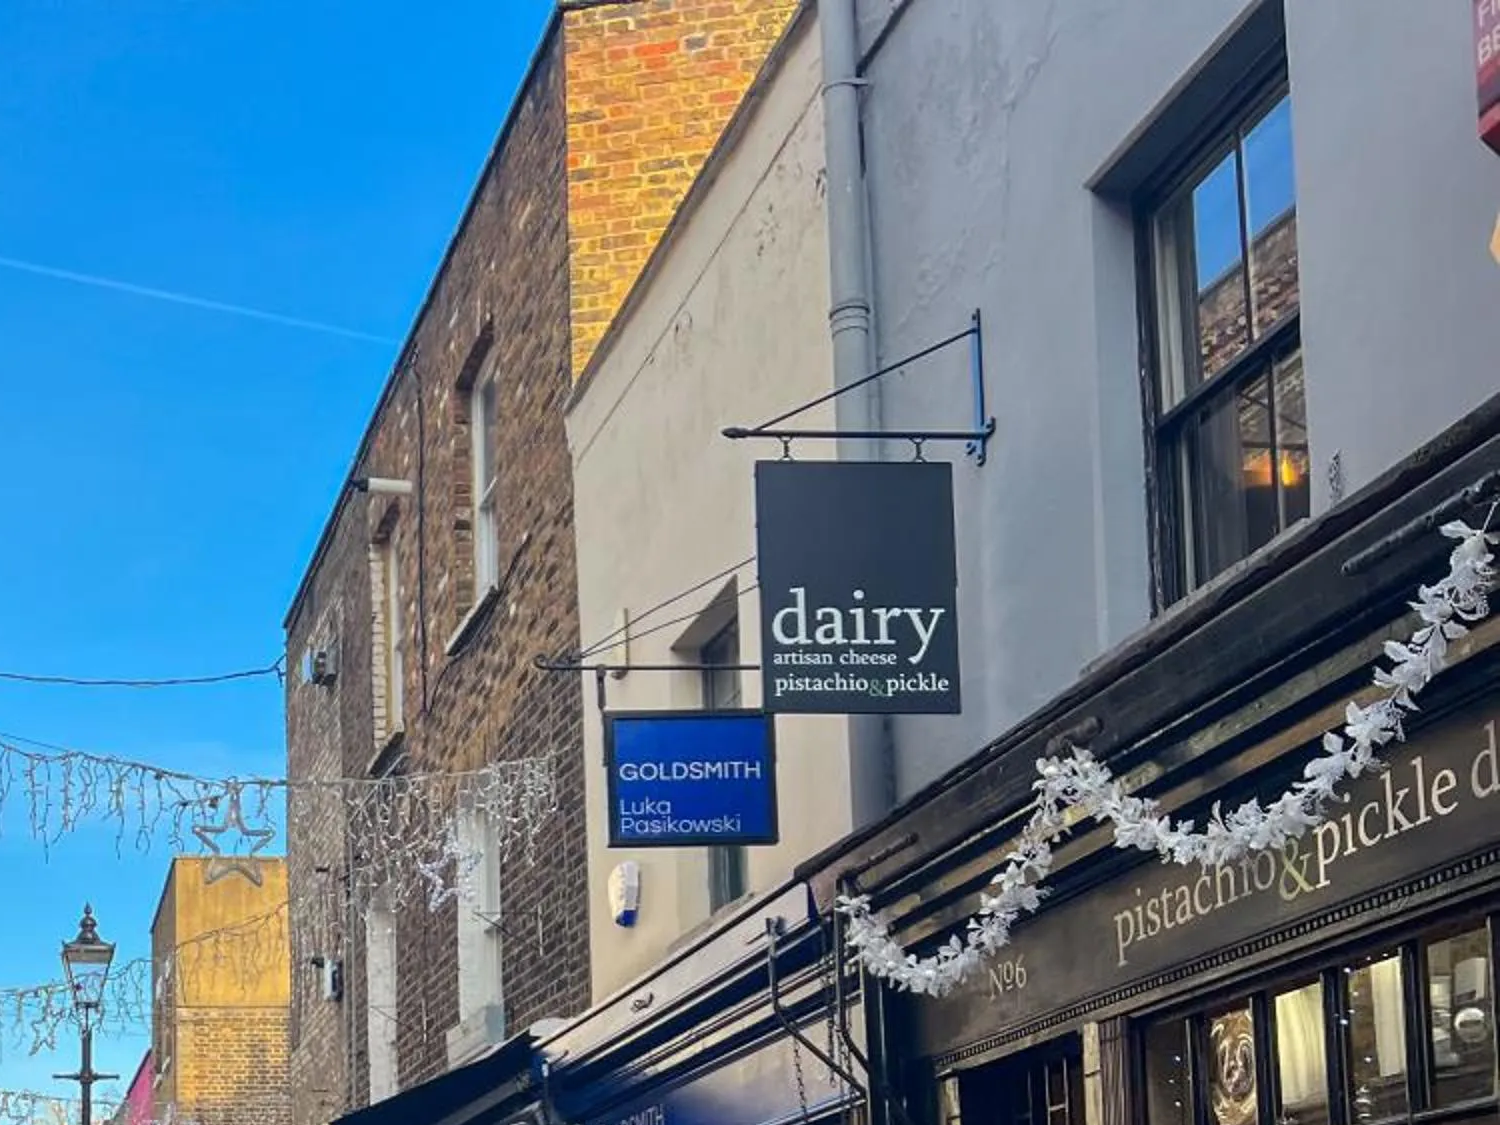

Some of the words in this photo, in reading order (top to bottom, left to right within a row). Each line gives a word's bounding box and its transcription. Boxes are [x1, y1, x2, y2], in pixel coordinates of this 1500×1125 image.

[771, 587, 946, 664] dairy
[773, 649, 833, 666] artisan
[839, 649, 898, 666] cheese
[619, 761, 761, 782] GOLDSMITH
[620, 798, 671, 816] Luka
[620, 813, 742, 835] Pasikowski
